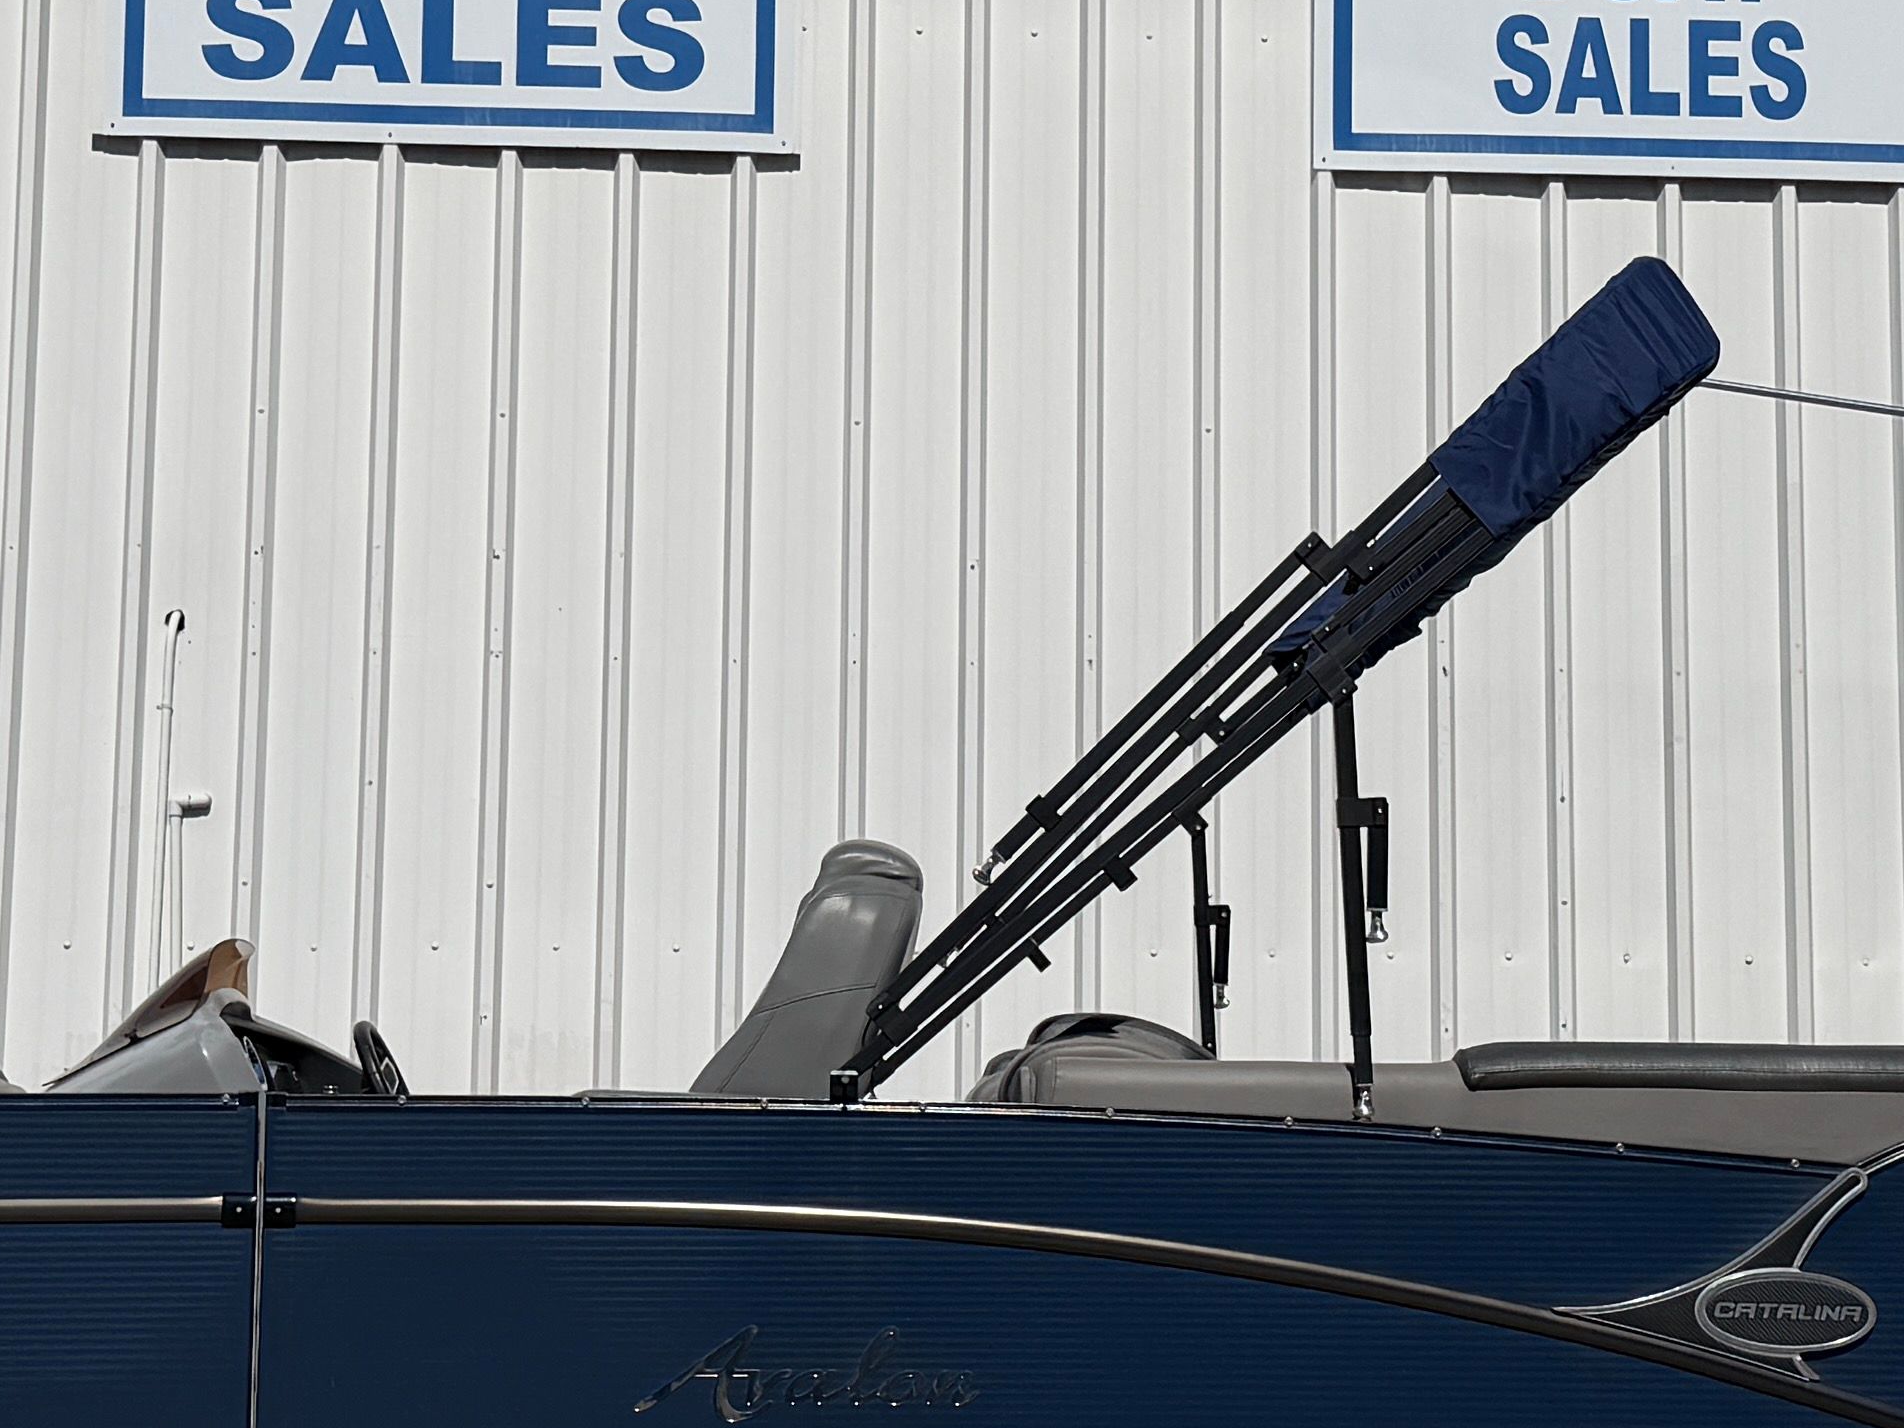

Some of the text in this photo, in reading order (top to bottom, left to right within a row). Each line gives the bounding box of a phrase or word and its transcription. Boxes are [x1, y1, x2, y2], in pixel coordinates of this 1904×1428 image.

[1494, 14, 1807, 120] SALES
[1714, 1301, 1863, 1322] CATALINA
[632, 1324, 980, 1424] Avalon
